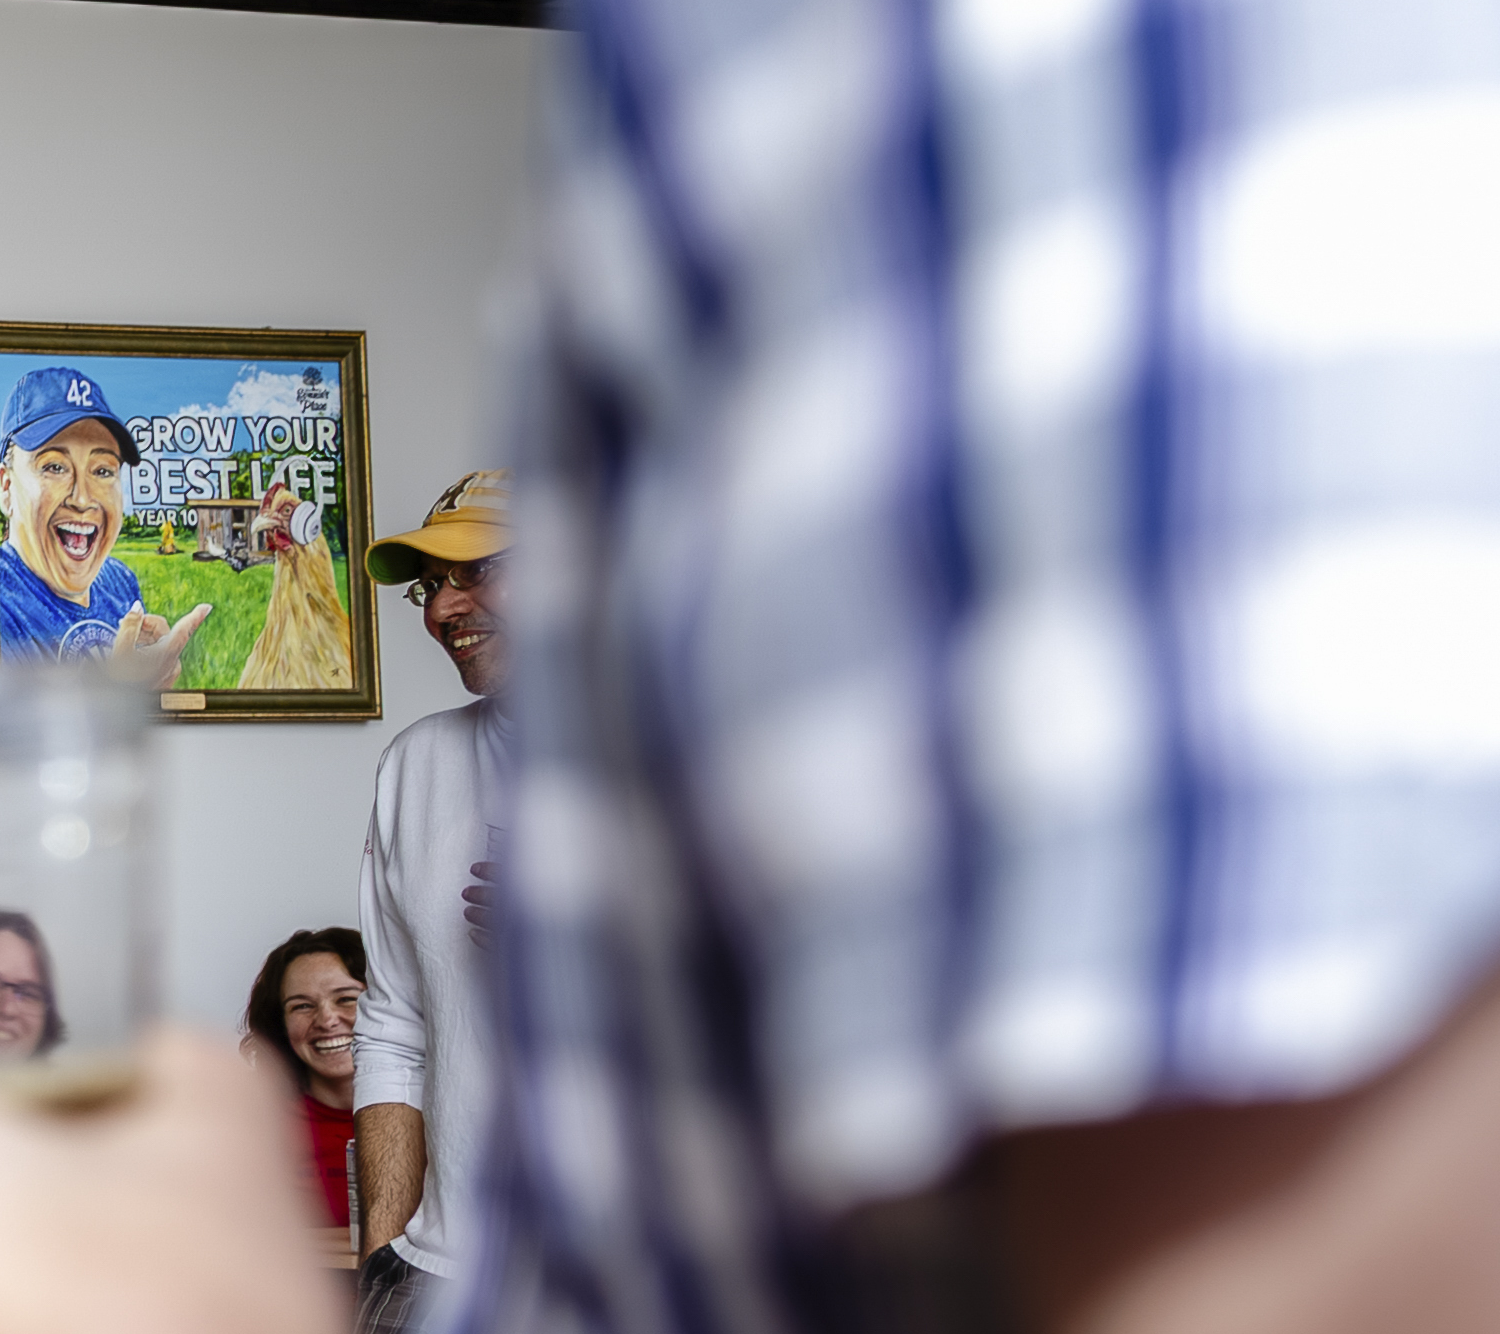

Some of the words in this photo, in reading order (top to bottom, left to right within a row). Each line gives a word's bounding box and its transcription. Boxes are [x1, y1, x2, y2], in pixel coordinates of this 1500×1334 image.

[66, 378, 94, 407] 42
[125, 415, 237, 454] GROW
[242, 415, 339, 453] YOUR
[129, 458, 239, 506] BEST
[251, 458, 338, 506] LIFE
[134, 508, 179, 527] YEAR
[180, 508, 199, 527] 10
